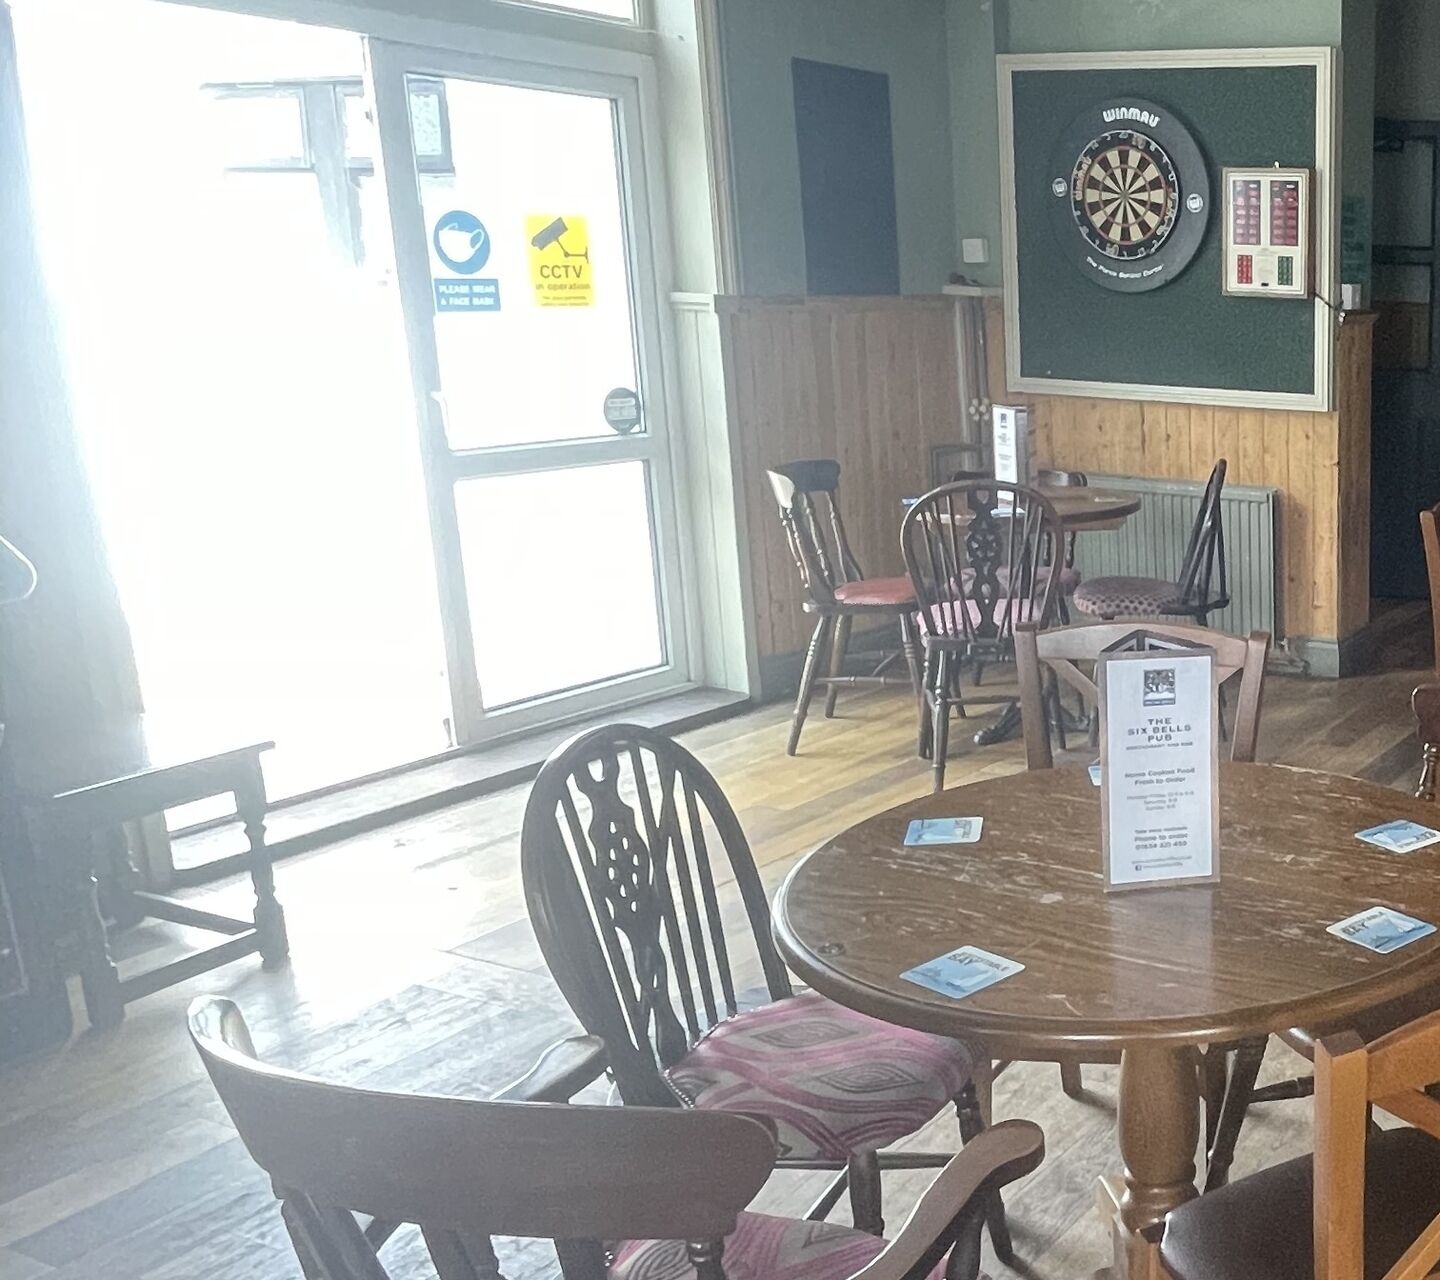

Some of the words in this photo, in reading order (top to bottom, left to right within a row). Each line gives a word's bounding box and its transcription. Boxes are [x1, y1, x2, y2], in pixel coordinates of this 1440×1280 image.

[1103, 107, 1160, 128] WINMAU
[540, 264, 582, 278] CCTV
[439, 285, 470, 293] PLEASE
[472, 285, 496, 293] WEAR
[547, 283, 591, 291] operation
[449, 297, 470, 305] FACE
[1147, 734, 1172, 742] PUB
